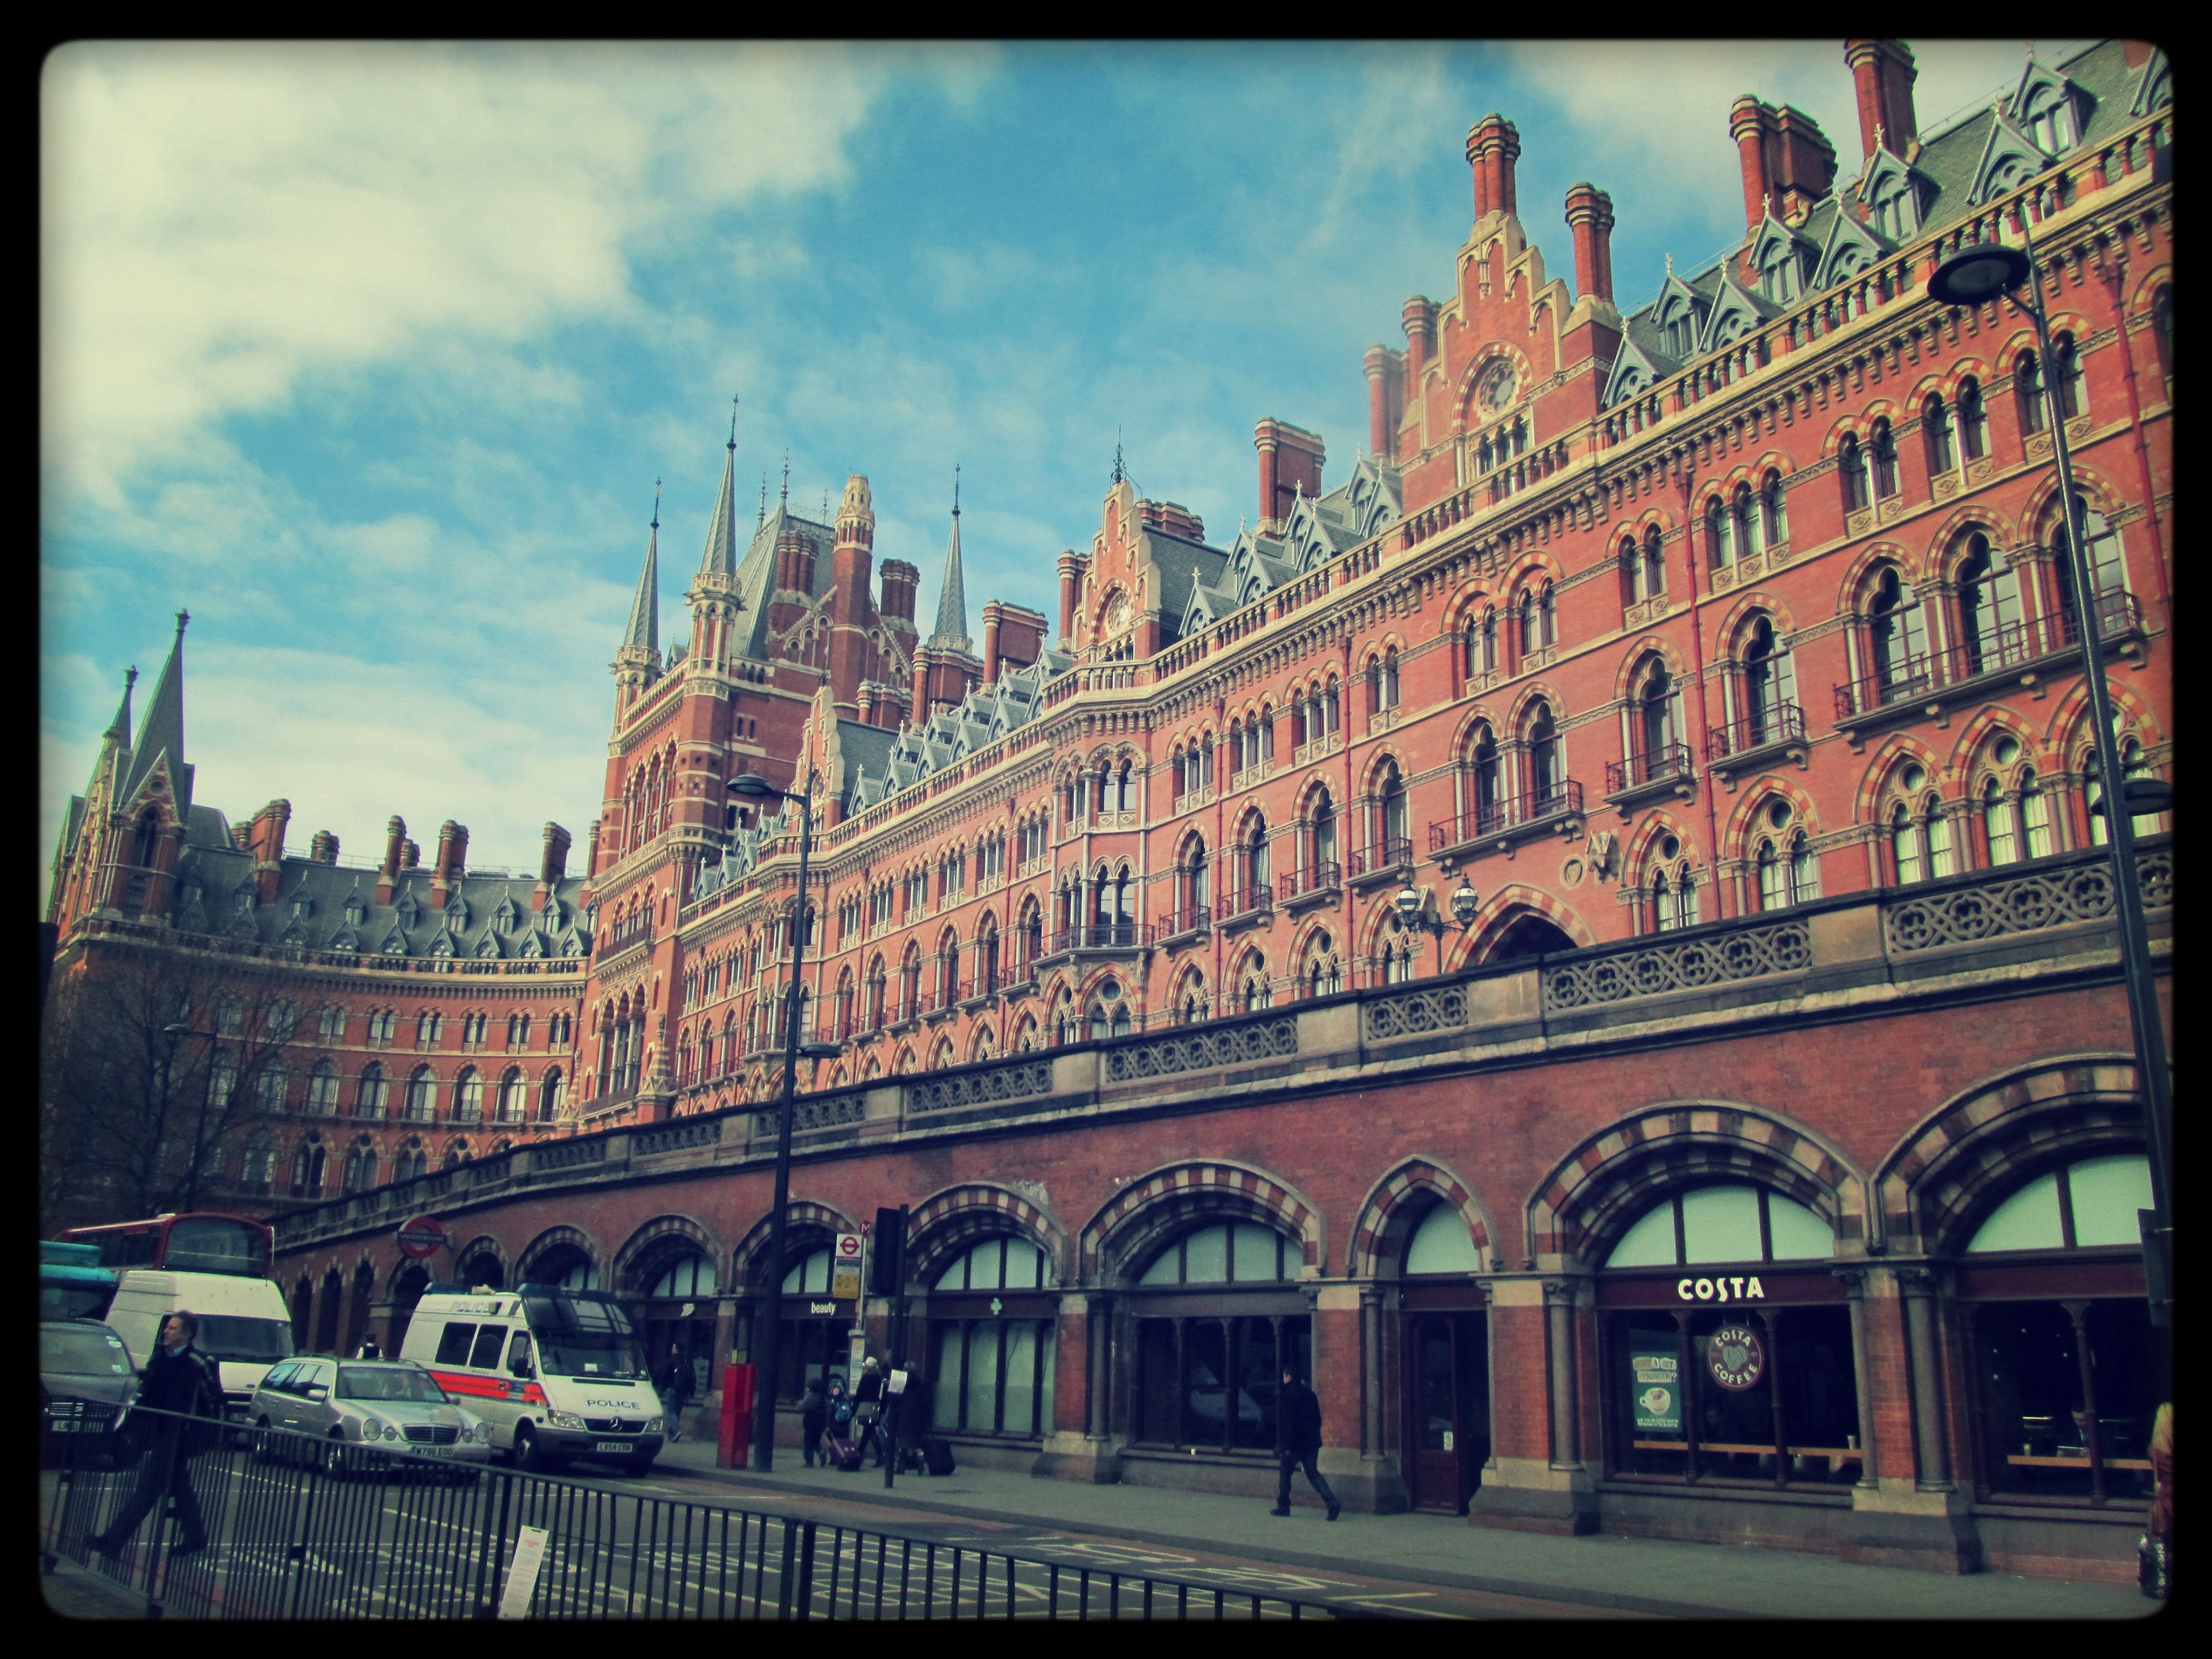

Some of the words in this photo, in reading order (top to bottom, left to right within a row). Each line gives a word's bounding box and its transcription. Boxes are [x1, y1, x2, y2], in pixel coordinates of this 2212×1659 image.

[861, 1223, 870, 1234] M
[399, 1234, 446, 1242] UNDERGROUND
[1678, 1277, 1765, 1302] COSTA
[811, 1302, 836, 1316] beauty
[1715, 1329, 1751, 1347] COSTA
[1715, 1363, 1757, 1384] COFFEE
[587, 1400, 640, 1410] POLICE
